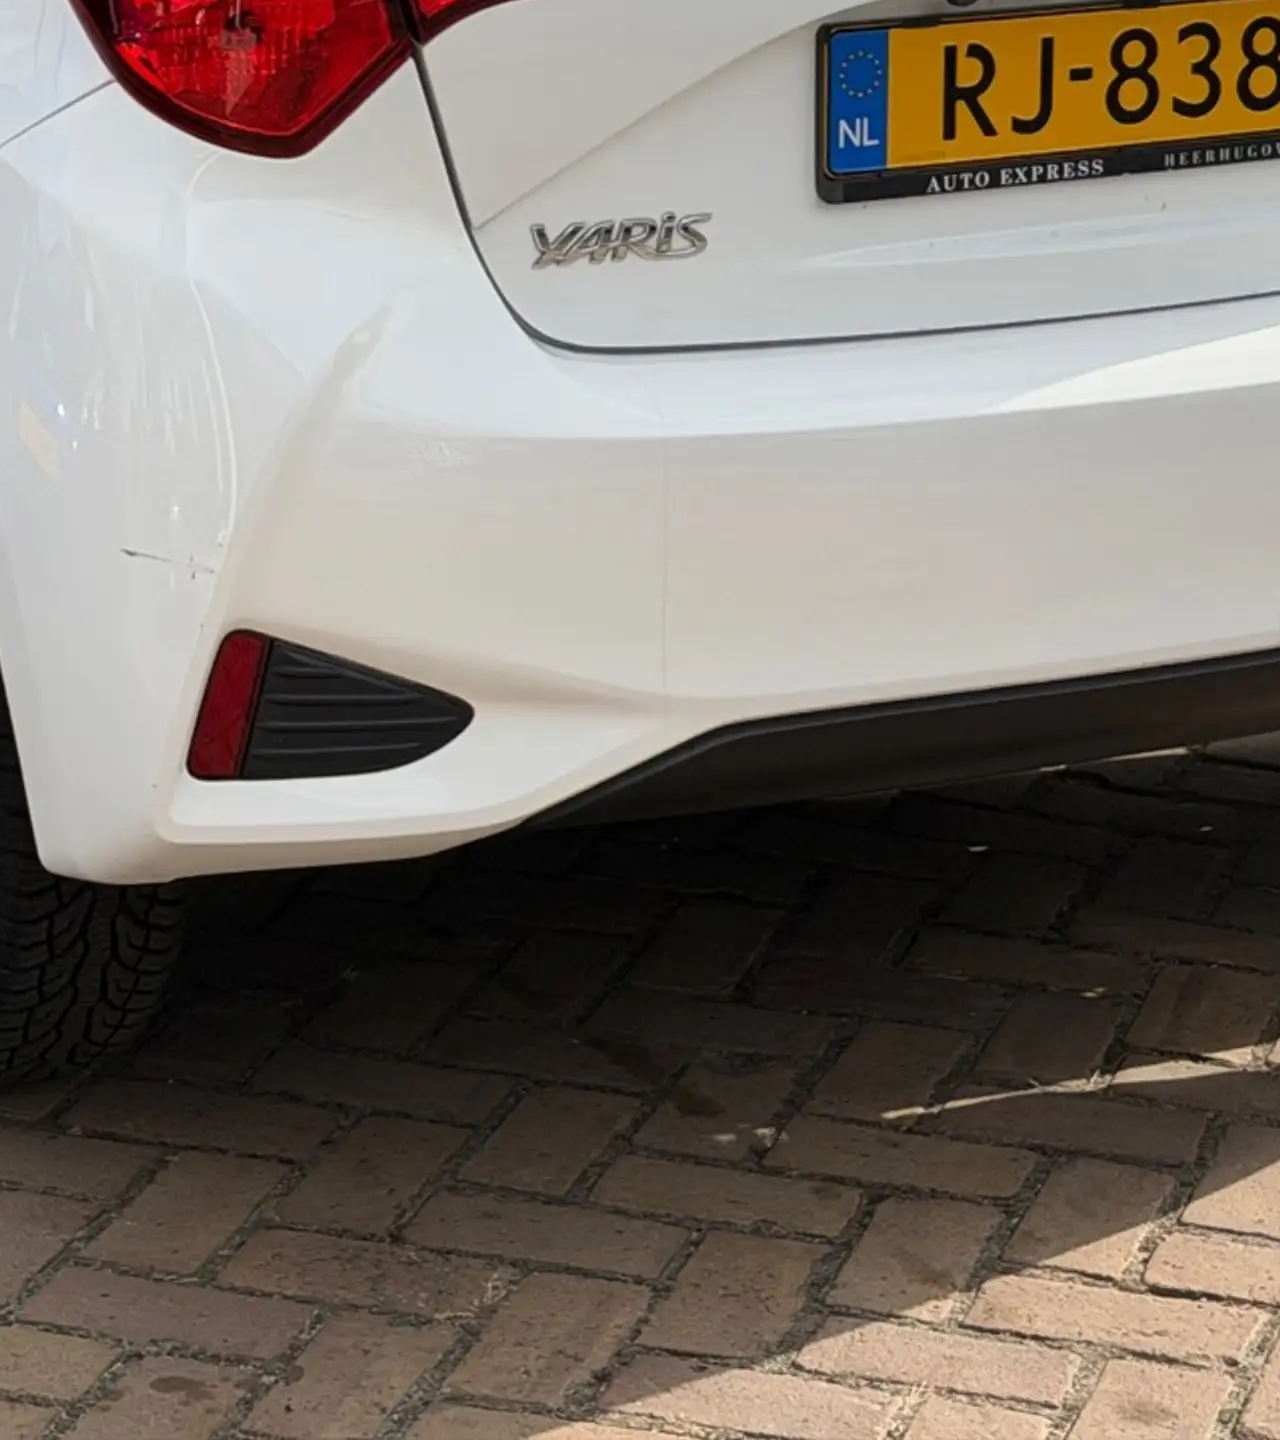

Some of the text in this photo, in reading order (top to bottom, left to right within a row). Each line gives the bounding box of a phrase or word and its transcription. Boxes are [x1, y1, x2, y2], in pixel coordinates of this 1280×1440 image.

[837, 116, 880, 149] NL
[926, 170, 991, 194] AUTO
[999, 159, 1106, 186] EXPRESS
